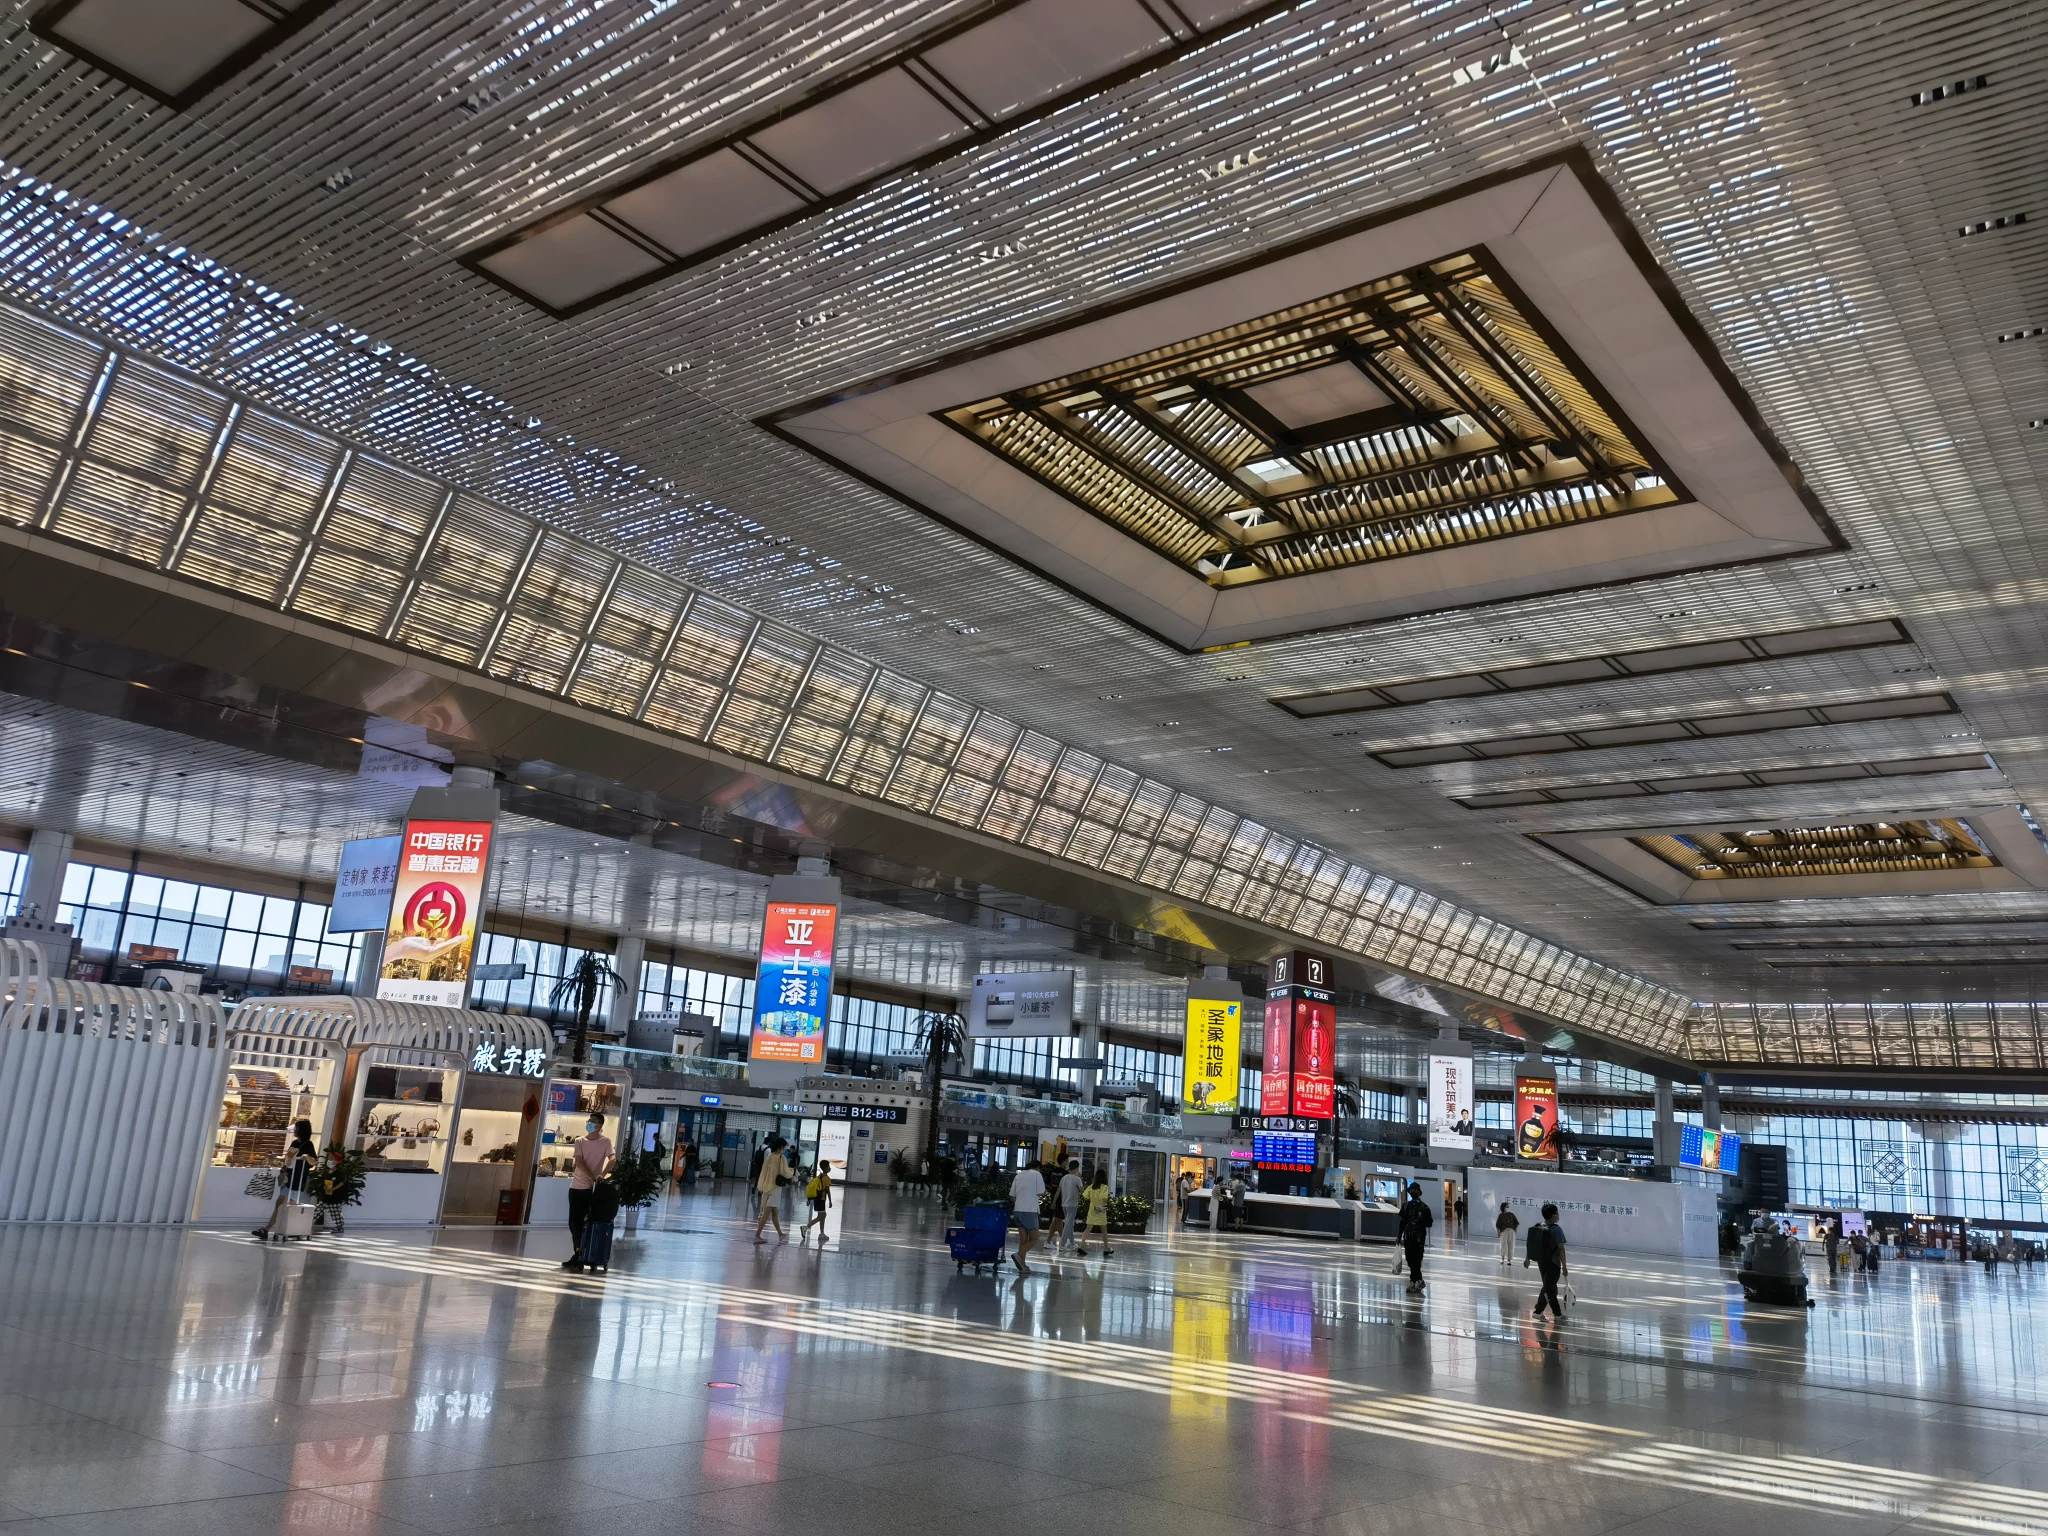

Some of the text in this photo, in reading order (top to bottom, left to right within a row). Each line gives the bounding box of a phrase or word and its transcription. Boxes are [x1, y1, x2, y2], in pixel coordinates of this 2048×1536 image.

[410, 832, 483, 852] 中国银行
[408, 854, 480, 874] 普惠金融
[340, 867, 368, 887] 定制家
[778, 919, 814, 1006] 亚士漆
[1276, 989, 1288, 997] 12306
[1313, 991, 1329, 1001] 12306
[1020, 1001, 1050, 1013] 小罐茶
[1205, 1009, 1225, 1078] 圣象地板
[1296, 1079, 1331, 1096] 国台国标
[1445, 1067, 1457, 1114] 现代筑美
[828, 1105, 848, 1113] 检票口
[851, 1107, 896, 1120] B12-B13
[1257, 1161, 1312, 1173] 南京南站欢迎您
